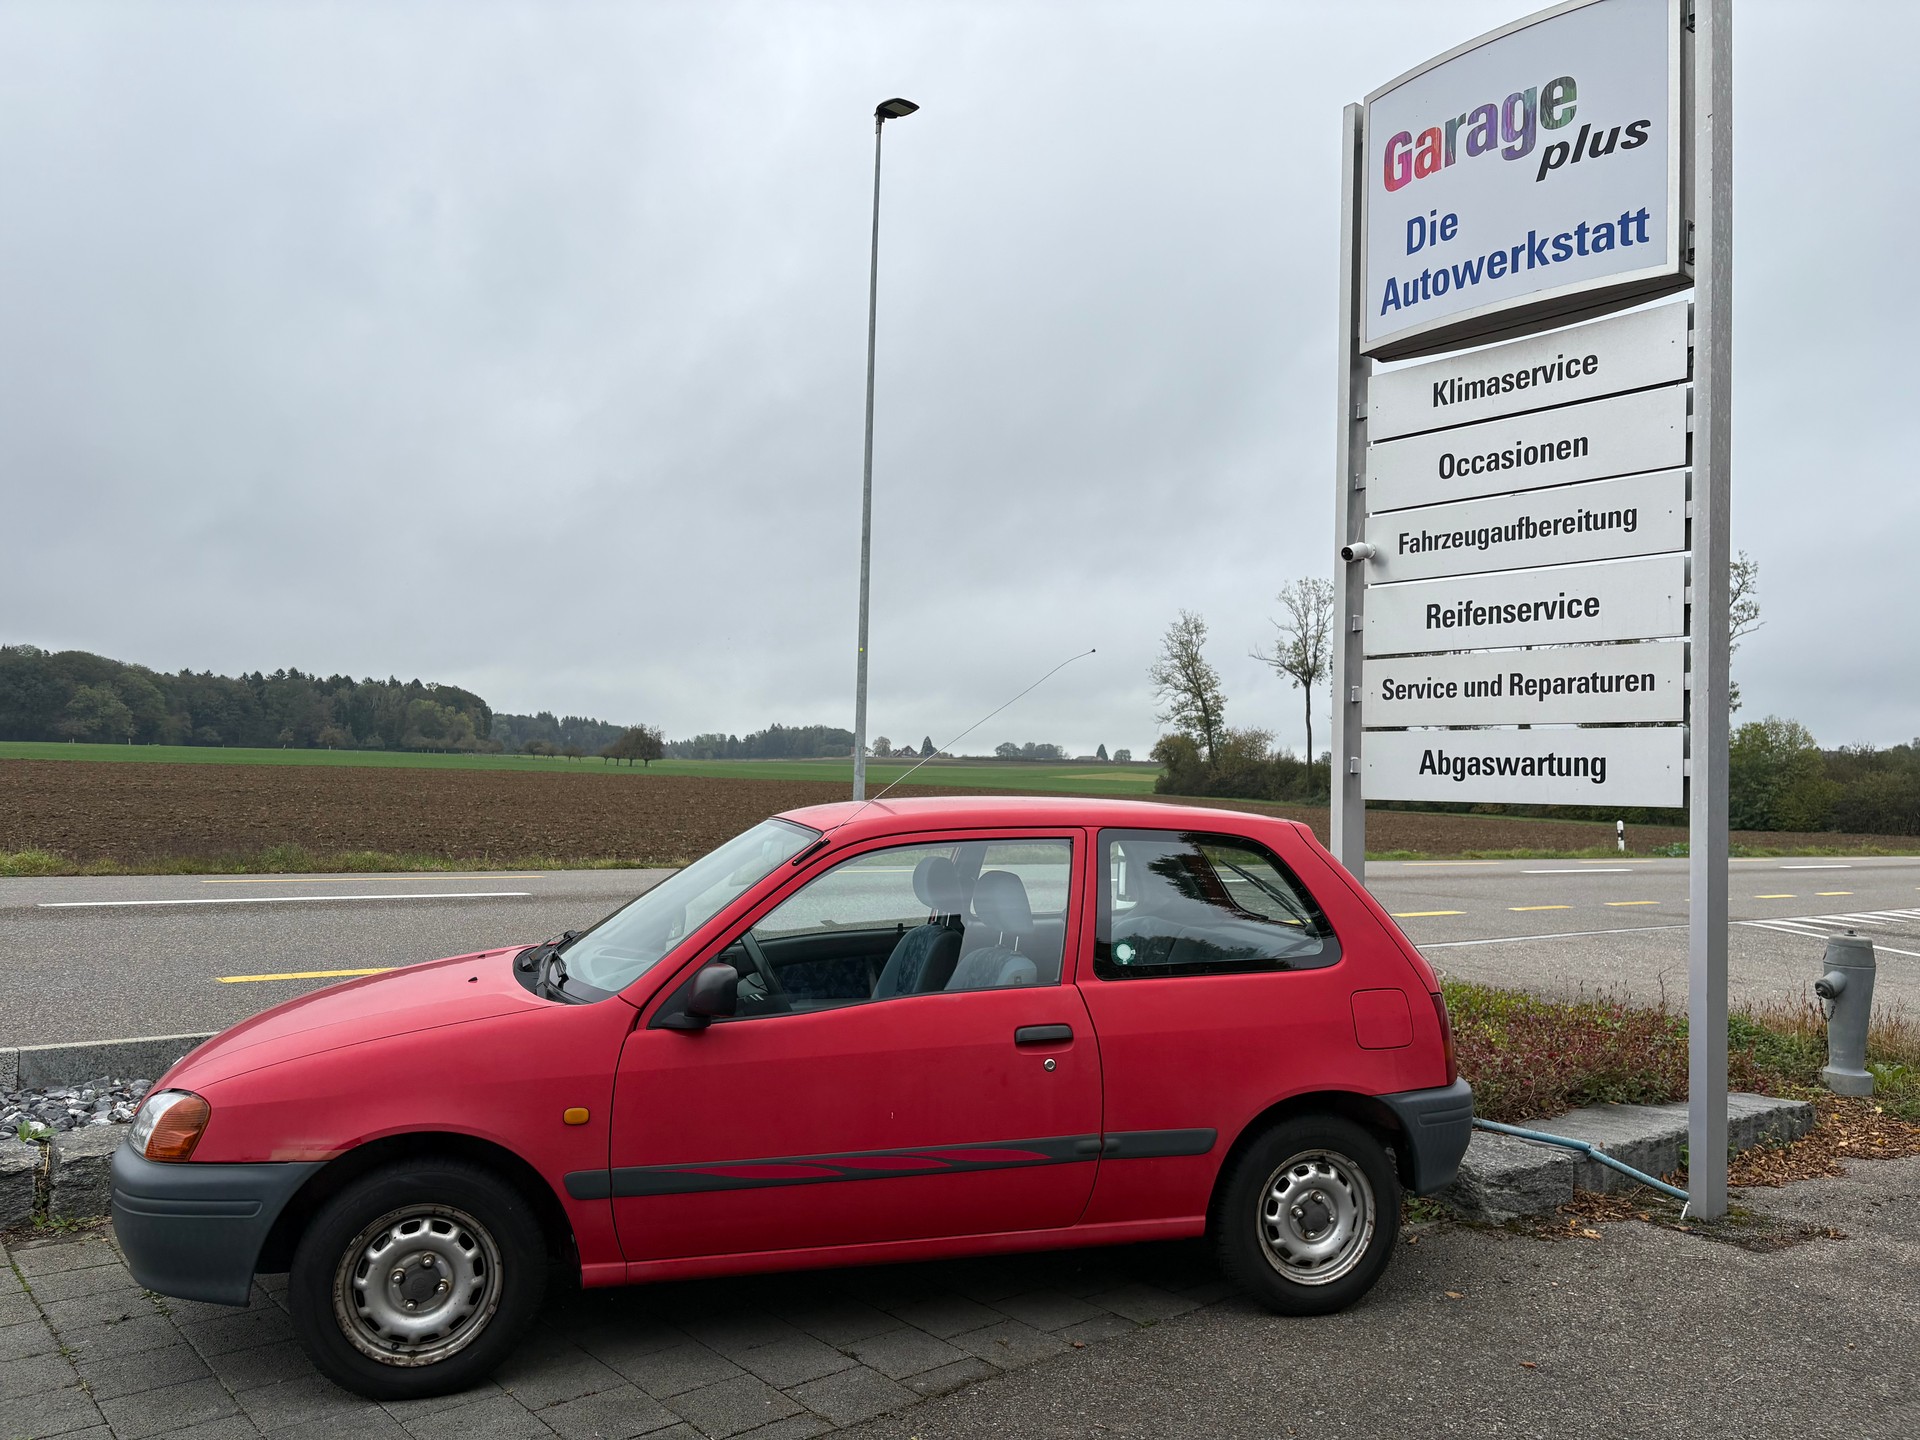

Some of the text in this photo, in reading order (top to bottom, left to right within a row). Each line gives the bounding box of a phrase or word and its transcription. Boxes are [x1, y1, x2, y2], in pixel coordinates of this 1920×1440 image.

[1382, 76, 1578, 193] Garage
[1535, 118, 1652, 182] plus
[1406, 209, 1458, 256] Die
[1380, 207, 1650, 316] Autowerkstatt
[1431, 352, 1599, 408] Klimaservice
[1438, 435, 1589, 480] Occasionen
[1398, 505, 1638, 555] Fahrzeugaufbereitung
[1426, 592, 1600, 630] Reifenservice
[1381, 670, 1655, 702] Service und Reparaturen
[1418, 749, 1607, 784] Abgaswartung
